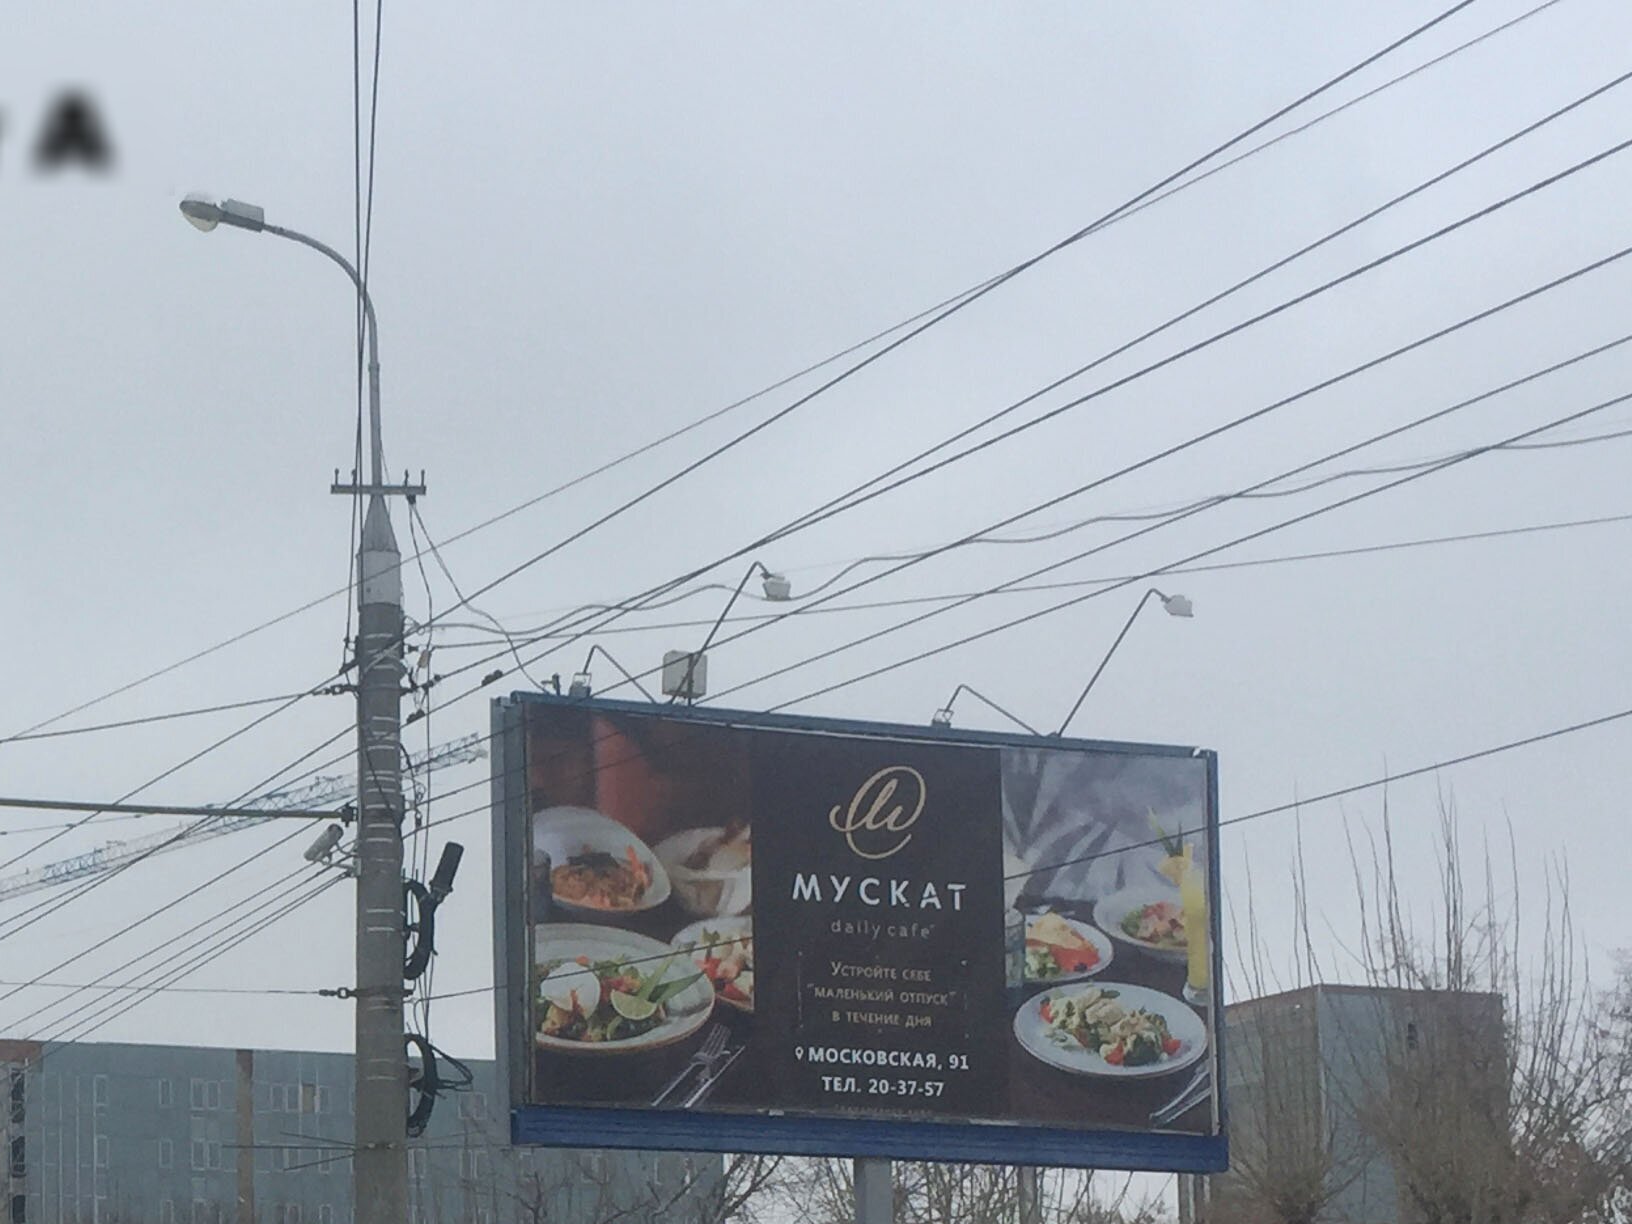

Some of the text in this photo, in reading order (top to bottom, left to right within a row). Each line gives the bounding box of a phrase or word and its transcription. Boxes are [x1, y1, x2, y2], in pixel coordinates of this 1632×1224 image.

[792, 873, 967, 911] МУСКАТ
[831, 920, 881, 939] daily
[808, 1047, 970, 1071] МОСКОВСКАЯ, 91
[821, 1076, 945, 1097] ТЕЛ. 20-37-57
